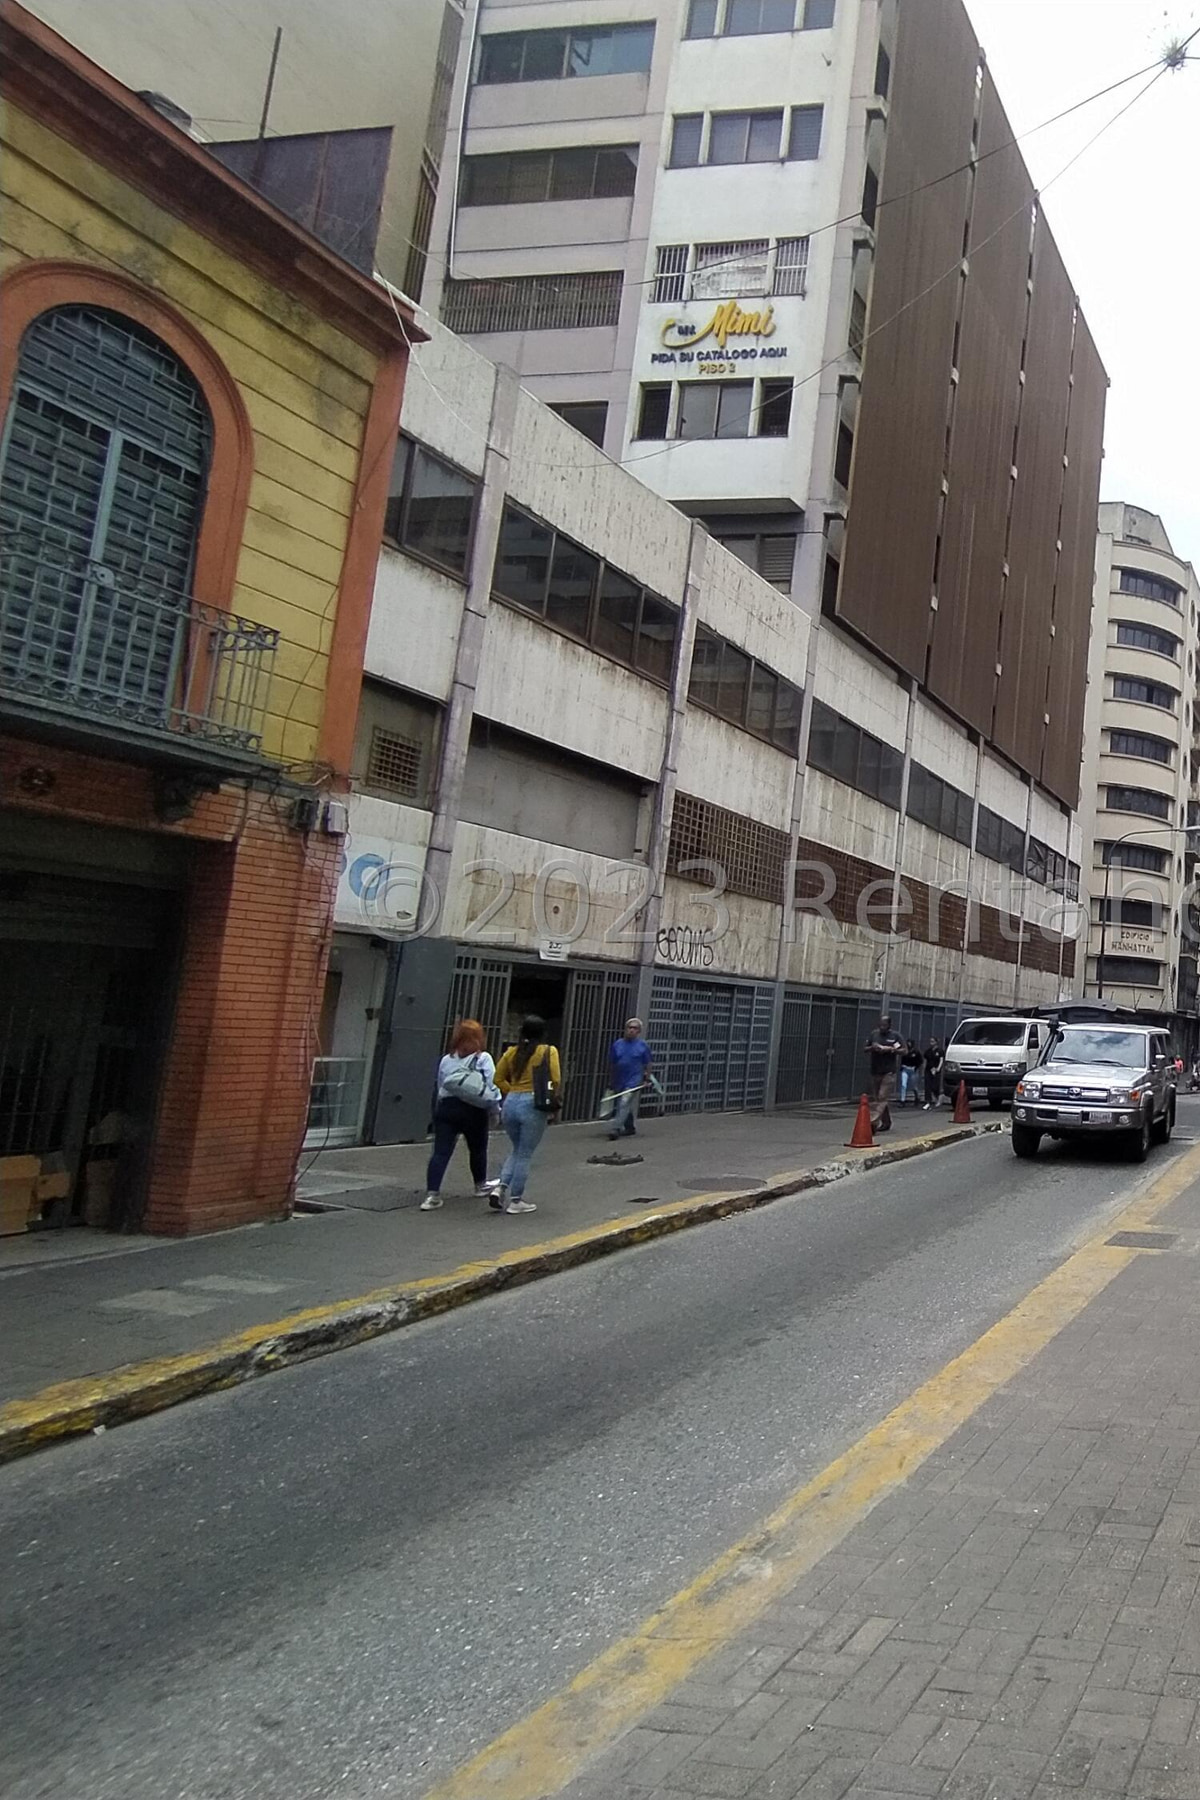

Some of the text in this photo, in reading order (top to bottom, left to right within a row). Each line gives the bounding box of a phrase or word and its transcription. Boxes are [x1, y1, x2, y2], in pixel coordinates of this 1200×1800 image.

[651, 353, 676, 363] PIDA
[699, 363, 726, 374] PISO
[1111, 941, 1154, 953] MANHATTAN
